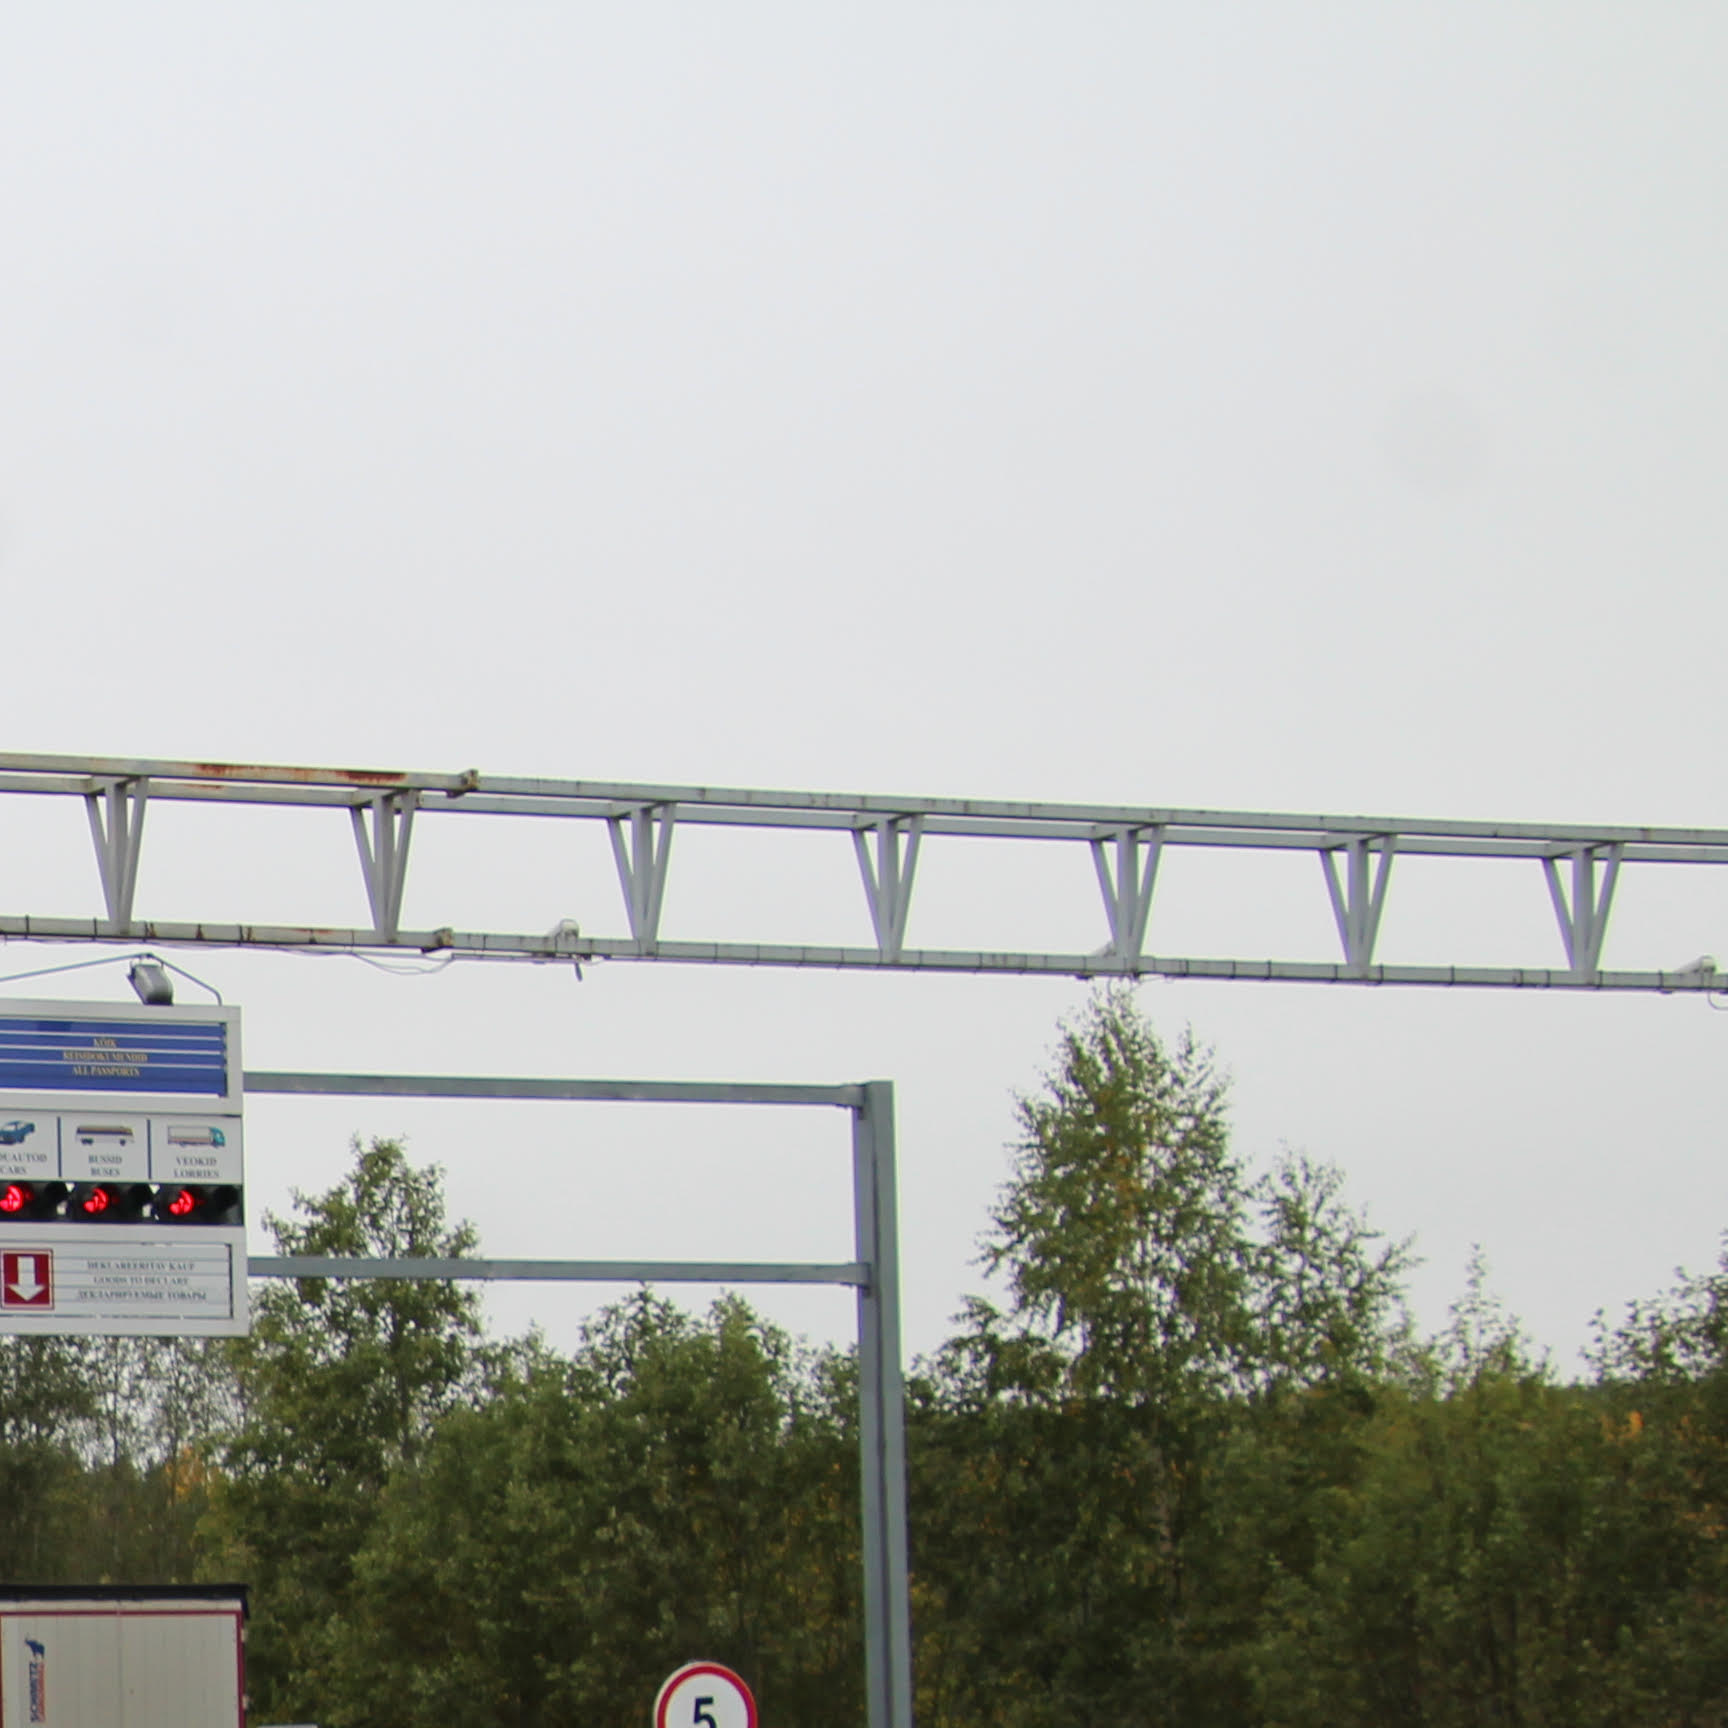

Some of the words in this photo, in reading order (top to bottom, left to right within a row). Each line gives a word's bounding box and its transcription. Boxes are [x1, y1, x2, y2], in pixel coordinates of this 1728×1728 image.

[72, 1066, 91, 1076] ALL
[92, 1066, 141, 1077] PASSPORTS
[88, 1155, 123, 1165] BUSSID
[176, 1156, 217, 1168] VEOKID
[0, 1165, 27, 1176] CARS
[90, 1167, 121, 1178] BUSES
